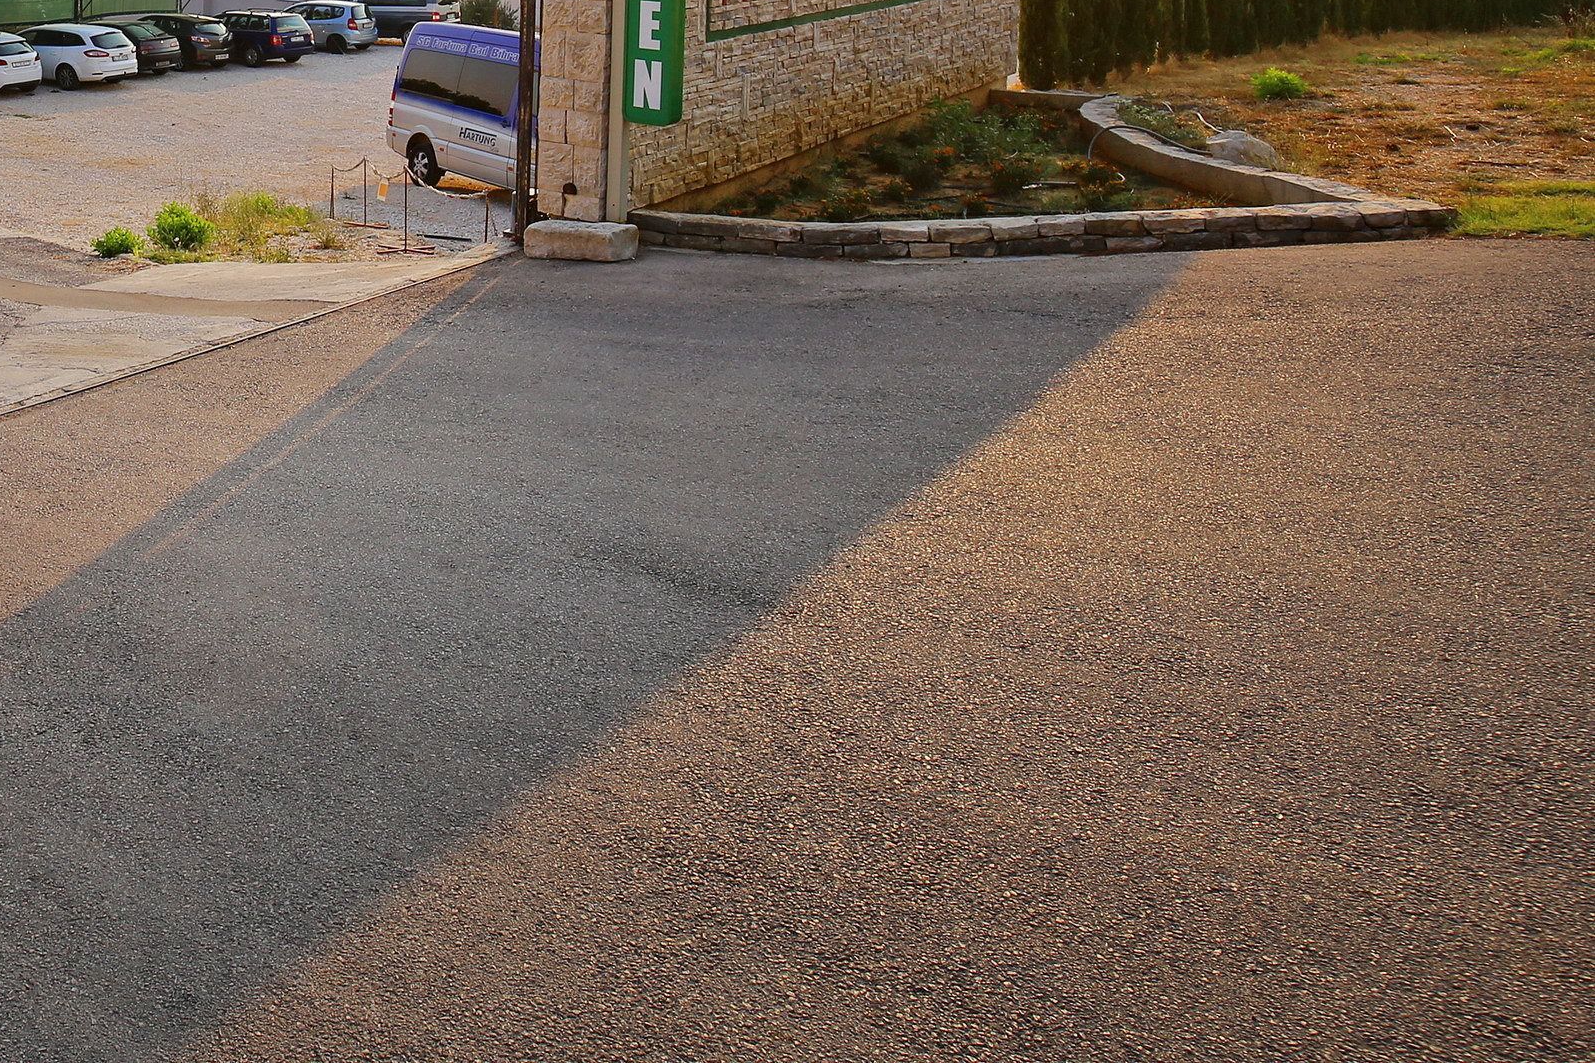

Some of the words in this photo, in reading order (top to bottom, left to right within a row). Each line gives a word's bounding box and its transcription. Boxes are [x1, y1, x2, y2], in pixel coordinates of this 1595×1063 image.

[416, 35, 431, 47] SG
[431, 37, 467, 52] Fortuna
[469, 43, 491, 57] Bad
[458, 126, 498, 147] HARTUNG
